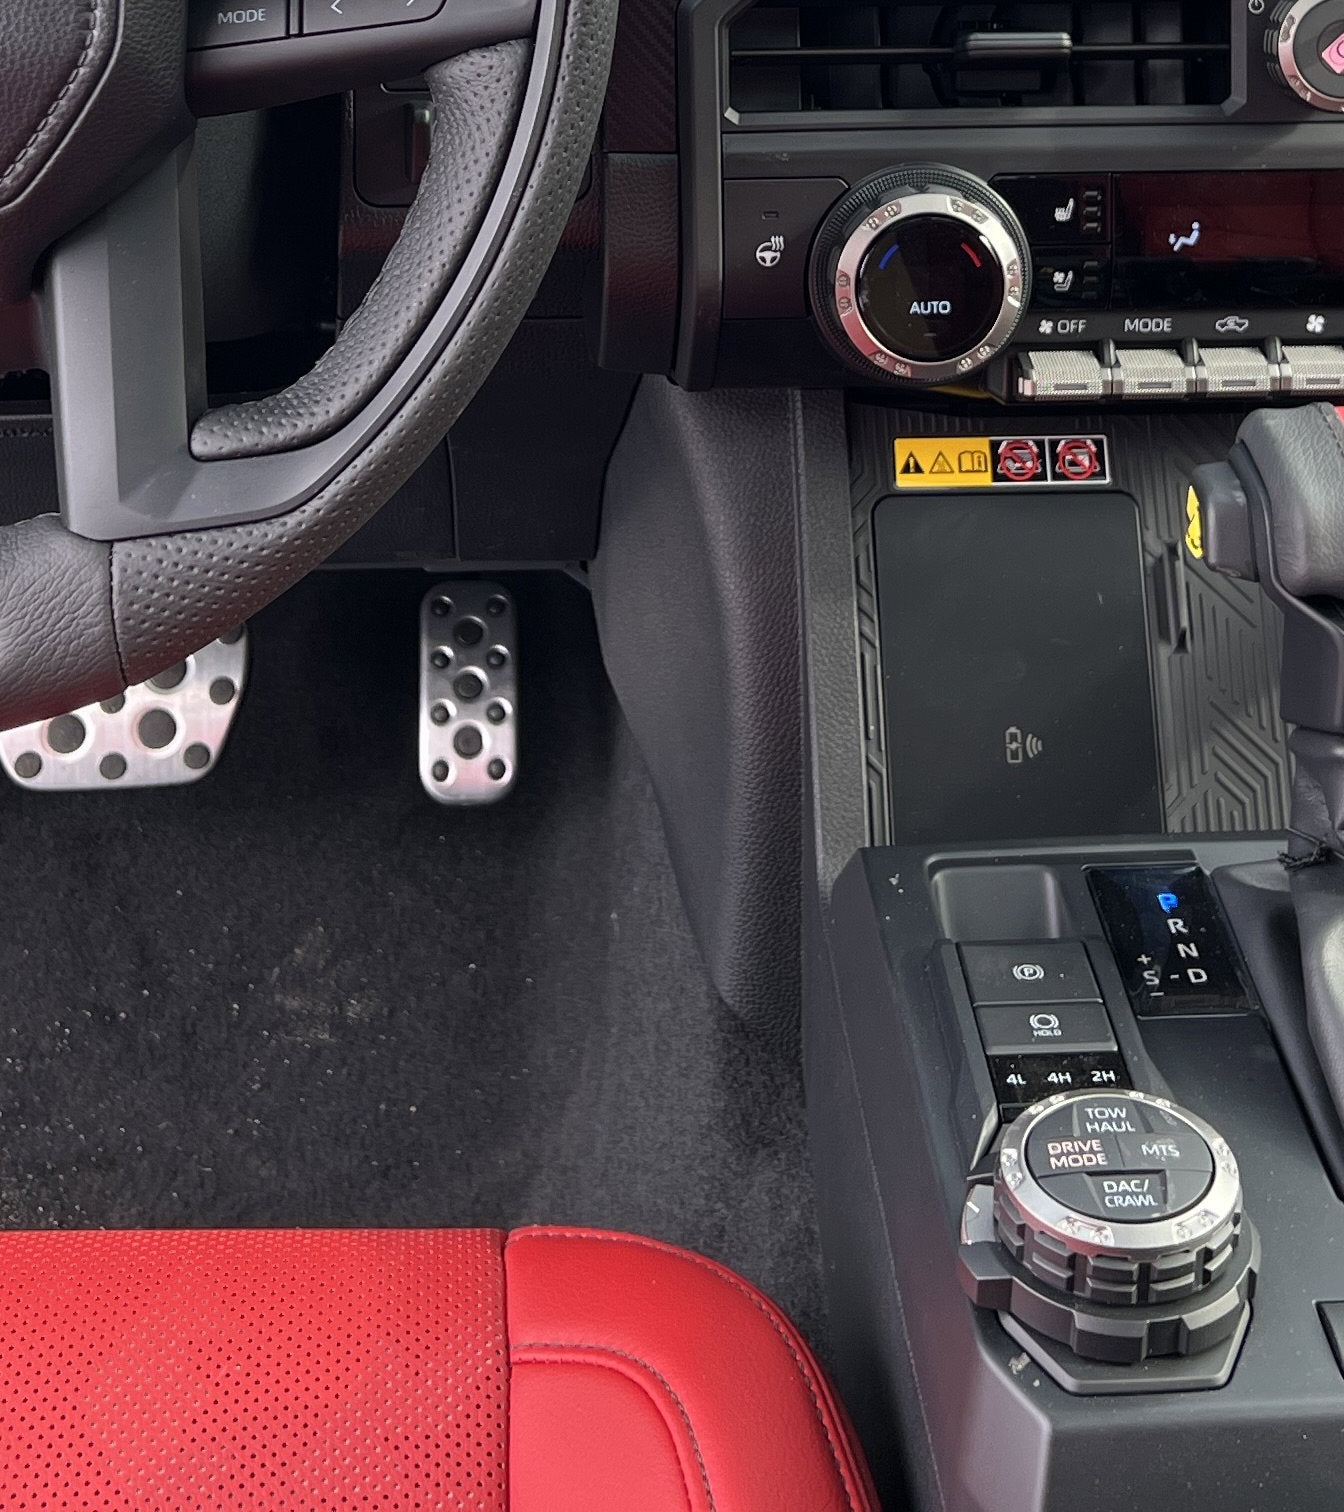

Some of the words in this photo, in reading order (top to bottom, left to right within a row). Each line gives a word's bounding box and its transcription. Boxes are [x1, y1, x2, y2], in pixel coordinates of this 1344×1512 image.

[217, 8, 267, 25] MODE
[909, 299, 951, 316] AUTO
[1056, 318, 1087, 335] OFF
[1124, 317, 1173, 333] MODE
[1158, 891, 1179, 913] P
[1167, 917, 1189, 934] R
[1178, 942, 1199, 959] N
[1143, 970, 1160, 985] S
[1187, 968, 1209, 984] D
[1033, 1028, 1062, 1037] HOLD
[1006, 1073, 1027, 1086] 4L
[1047, 1072, 1072, 1084] 4H
[1091, 1070, 1116, 1083] 2H
[1084, 1106, 1127, 1120] TOW
[1085, 1119, 1136, 1133] HAUL
[1047, 1138, 1103, 1155] DRIVE
[1141, 1143, 1180, 1158] MTS
[1049, 1152, 1108, 1170] MODE
[1103, 1178, 1149, 1194] DAC/
[1104, 1193, 1159, 1208] CRAWL
